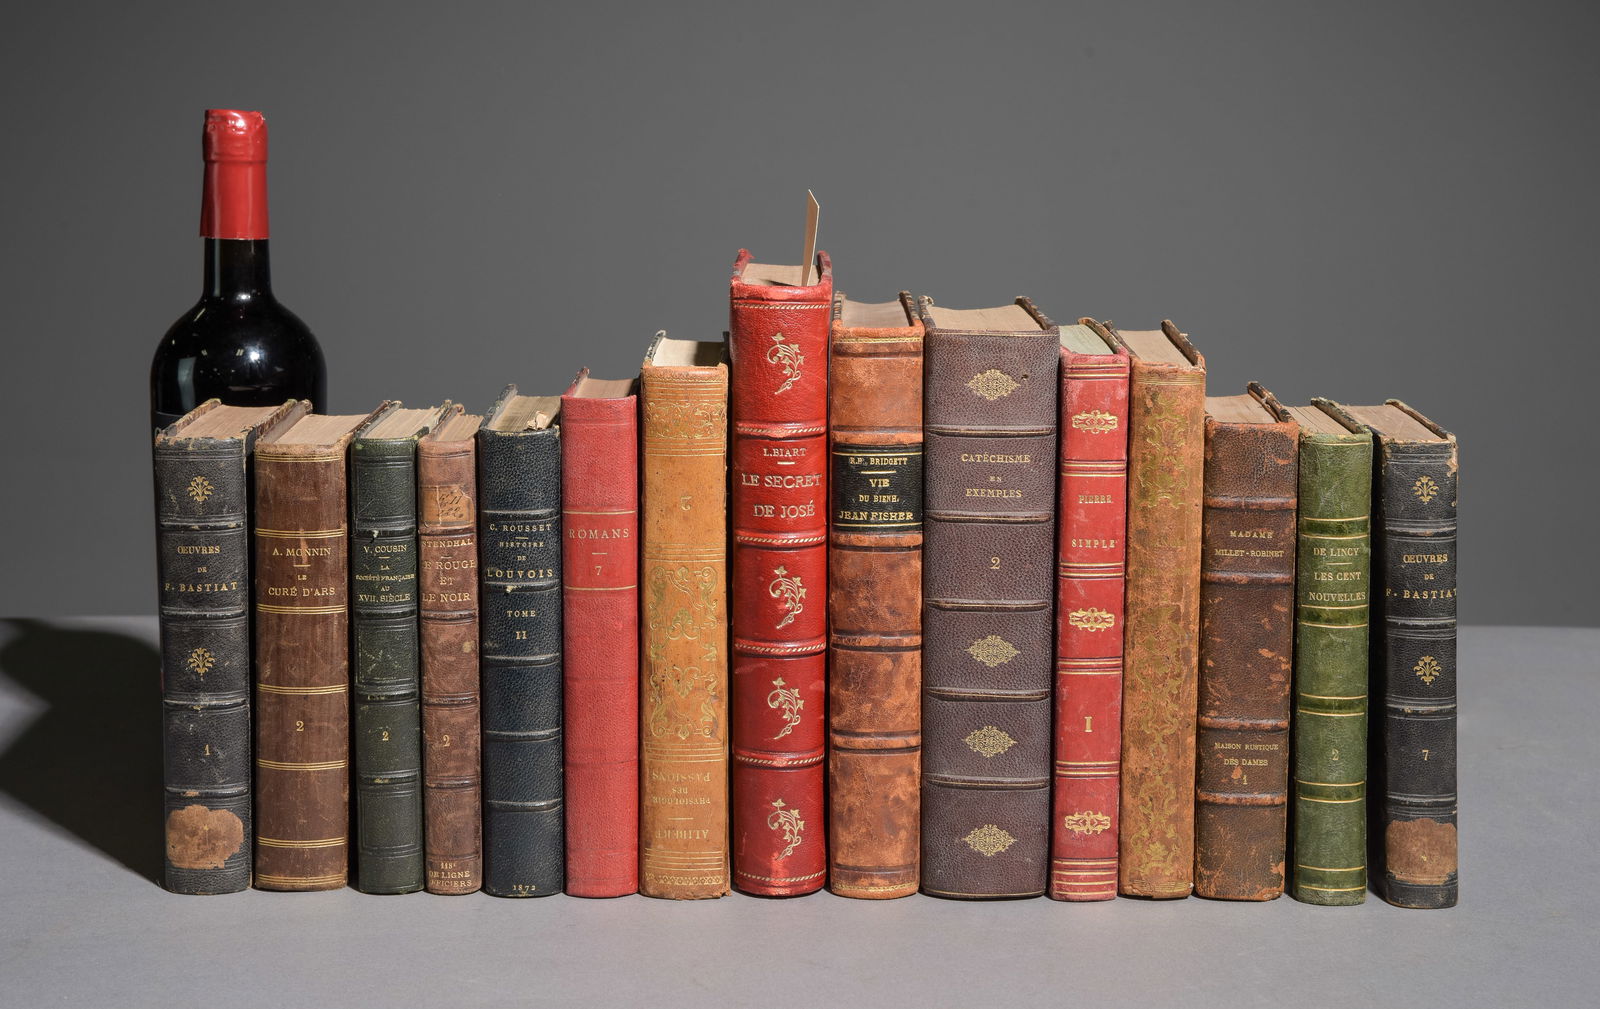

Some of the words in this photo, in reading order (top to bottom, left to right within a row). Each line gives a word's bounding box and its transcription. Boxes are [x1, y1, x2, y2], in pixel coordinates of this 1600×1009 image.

[870, 457, 908, 465] BRIDGETT
[961, 451, 1031, 463] CATÉCHISME
[741, 473, 760, 486] LE
[764, 474, 822, 489] SECRET
[869, 478, 890, 488] VIE
[859, 494, 870, 502] DU
[965, 488, 1022, 498] EXEMPLES
[1079, 494, 1112, 504] PIERRE
[753, 504, 775, 518] DE
[780, 499, 816, 519] JOSÉ
[839, 510, 868, 520] JEAN
[870, 511, 914, 520] FISHER
[490, 523, 498, 531] C.
[502, 524, 552, 532] ROUSSET
[568, 528, 630, 539] ROMANS
[1230, 530, 1274, 539] MADAME
[422, 538, 473, 548] STENDHAL
[1071, 538, 1116, 548] SIMPLE
[177, 545, 220, 554] ŒUVRES
[272, 548, 283, 556] A.
[286, 547, 331, 556] MONNIN
[363, 546, 373, 554] V.
[375, 544, 407, 553] COUSIN
[1313, 547, 1327, 556] DE
[1330, 547, 1359, 557] LINCY
[990, 556, 1000, 570] 2
[1402, 553, 1448, 563] ŒUVRES
[435, 559, 476, 570] ROUGE
[487, 568, 553, 579] LOUVOIS
[594, 566, 602, 576] 7
[1314, 571, 1334, 581] LES
[1336, 571, 1361, 581] CENT
[439, 576, 455, 585] ET
[180, 581, 237, 592] BASTIAT
[268, 586, 298, 596] CURÉ
[302, 587, 336, 597] D'ARS
[422, 592, 436, 602] LE
[440, 592, 471, 602] NOIR
[1308, 591, 1366, 602] NOUVELLES
[1386, 588, 1397, 597] F.
[380, 593, 411, 603] SIÈCLE
[506, 610, 536, 618] TOME
[515, 630, 527, 640] II
[296, 721, 304, 732] 2
[382, 731, 389, 741] 2
[443, 735, 451, 747] 2
[204, 744, 211, 755] 1
[1214, 742, 1242, 750] MAISON
[1331, 750, 1339, 761] 2
[1422, 750, 1430, 761] 7
[1224, 758, 1239, 766] DES
[1241, 758, 1268, 766] DAMES
[441, 870, 471, 879] LIGNE
